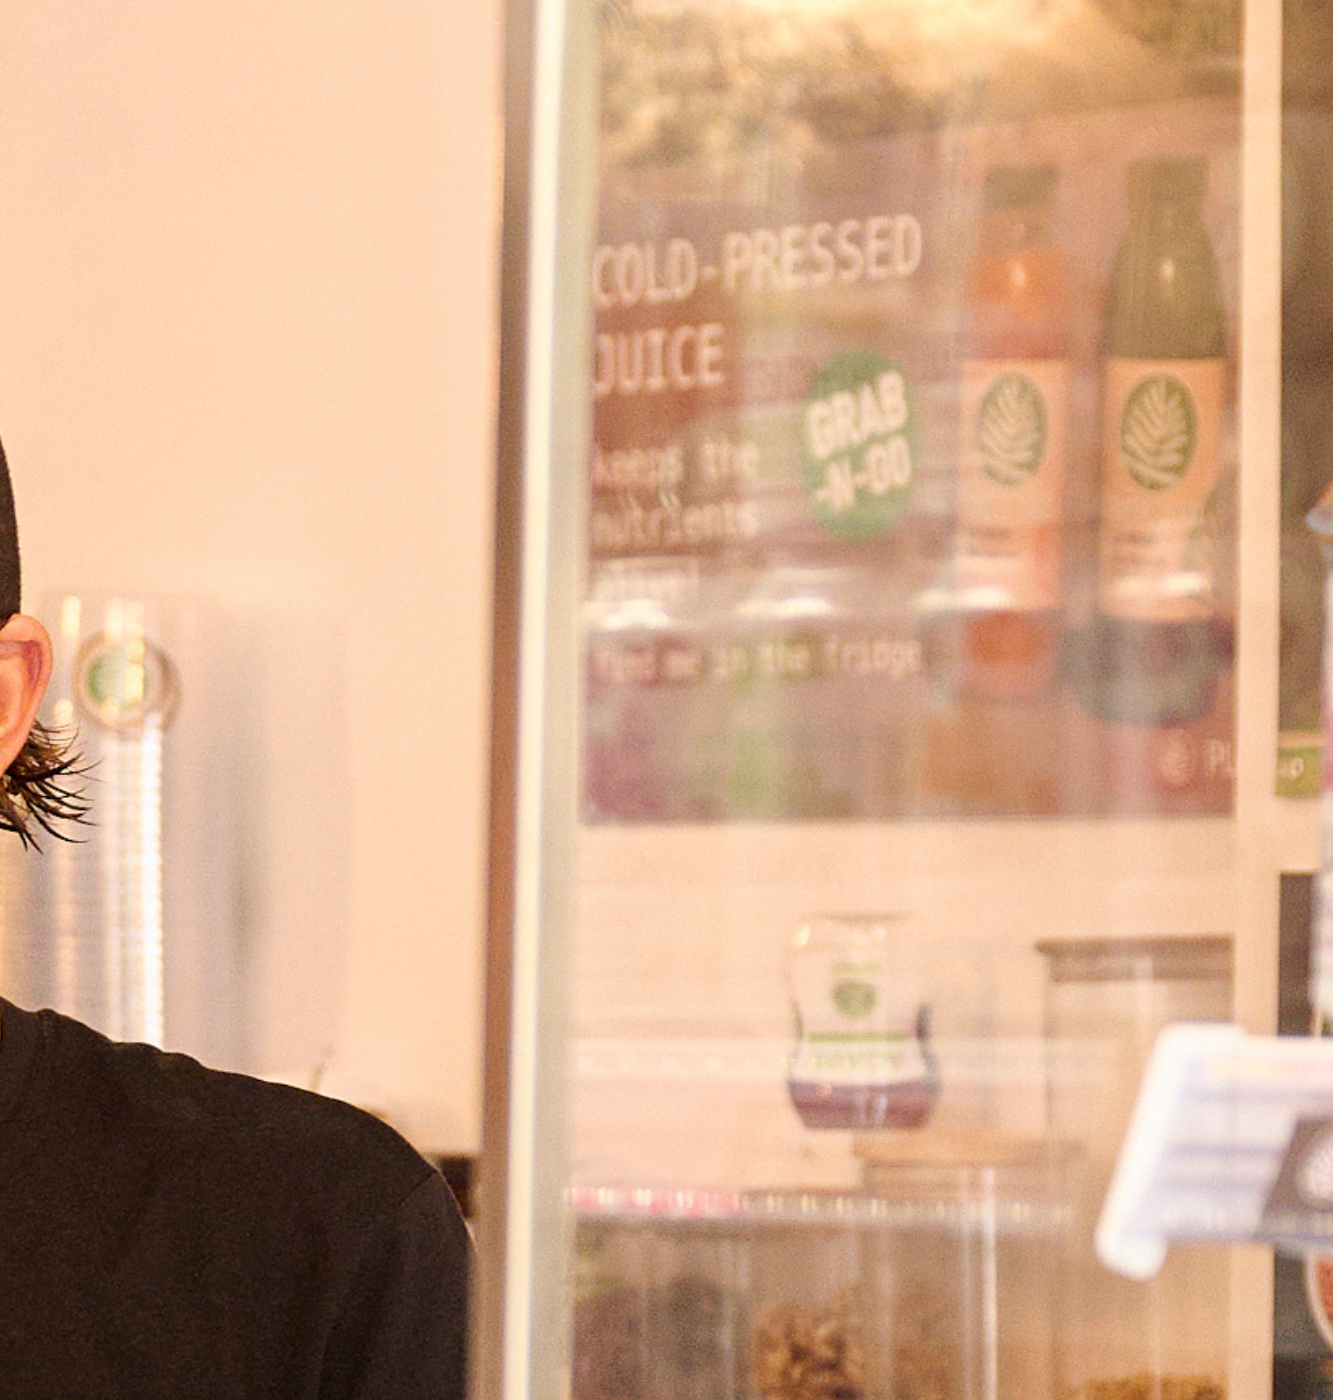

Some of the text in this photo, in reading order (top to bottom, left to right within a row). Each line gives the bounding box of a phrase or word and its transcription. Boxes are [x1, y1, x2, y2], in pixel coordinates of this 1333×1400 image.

[592, 214, 923, 309] COLD-PRESSED
[593, 322, 725, 398] JUICE
[806, 371, 909, 459] GRAB
